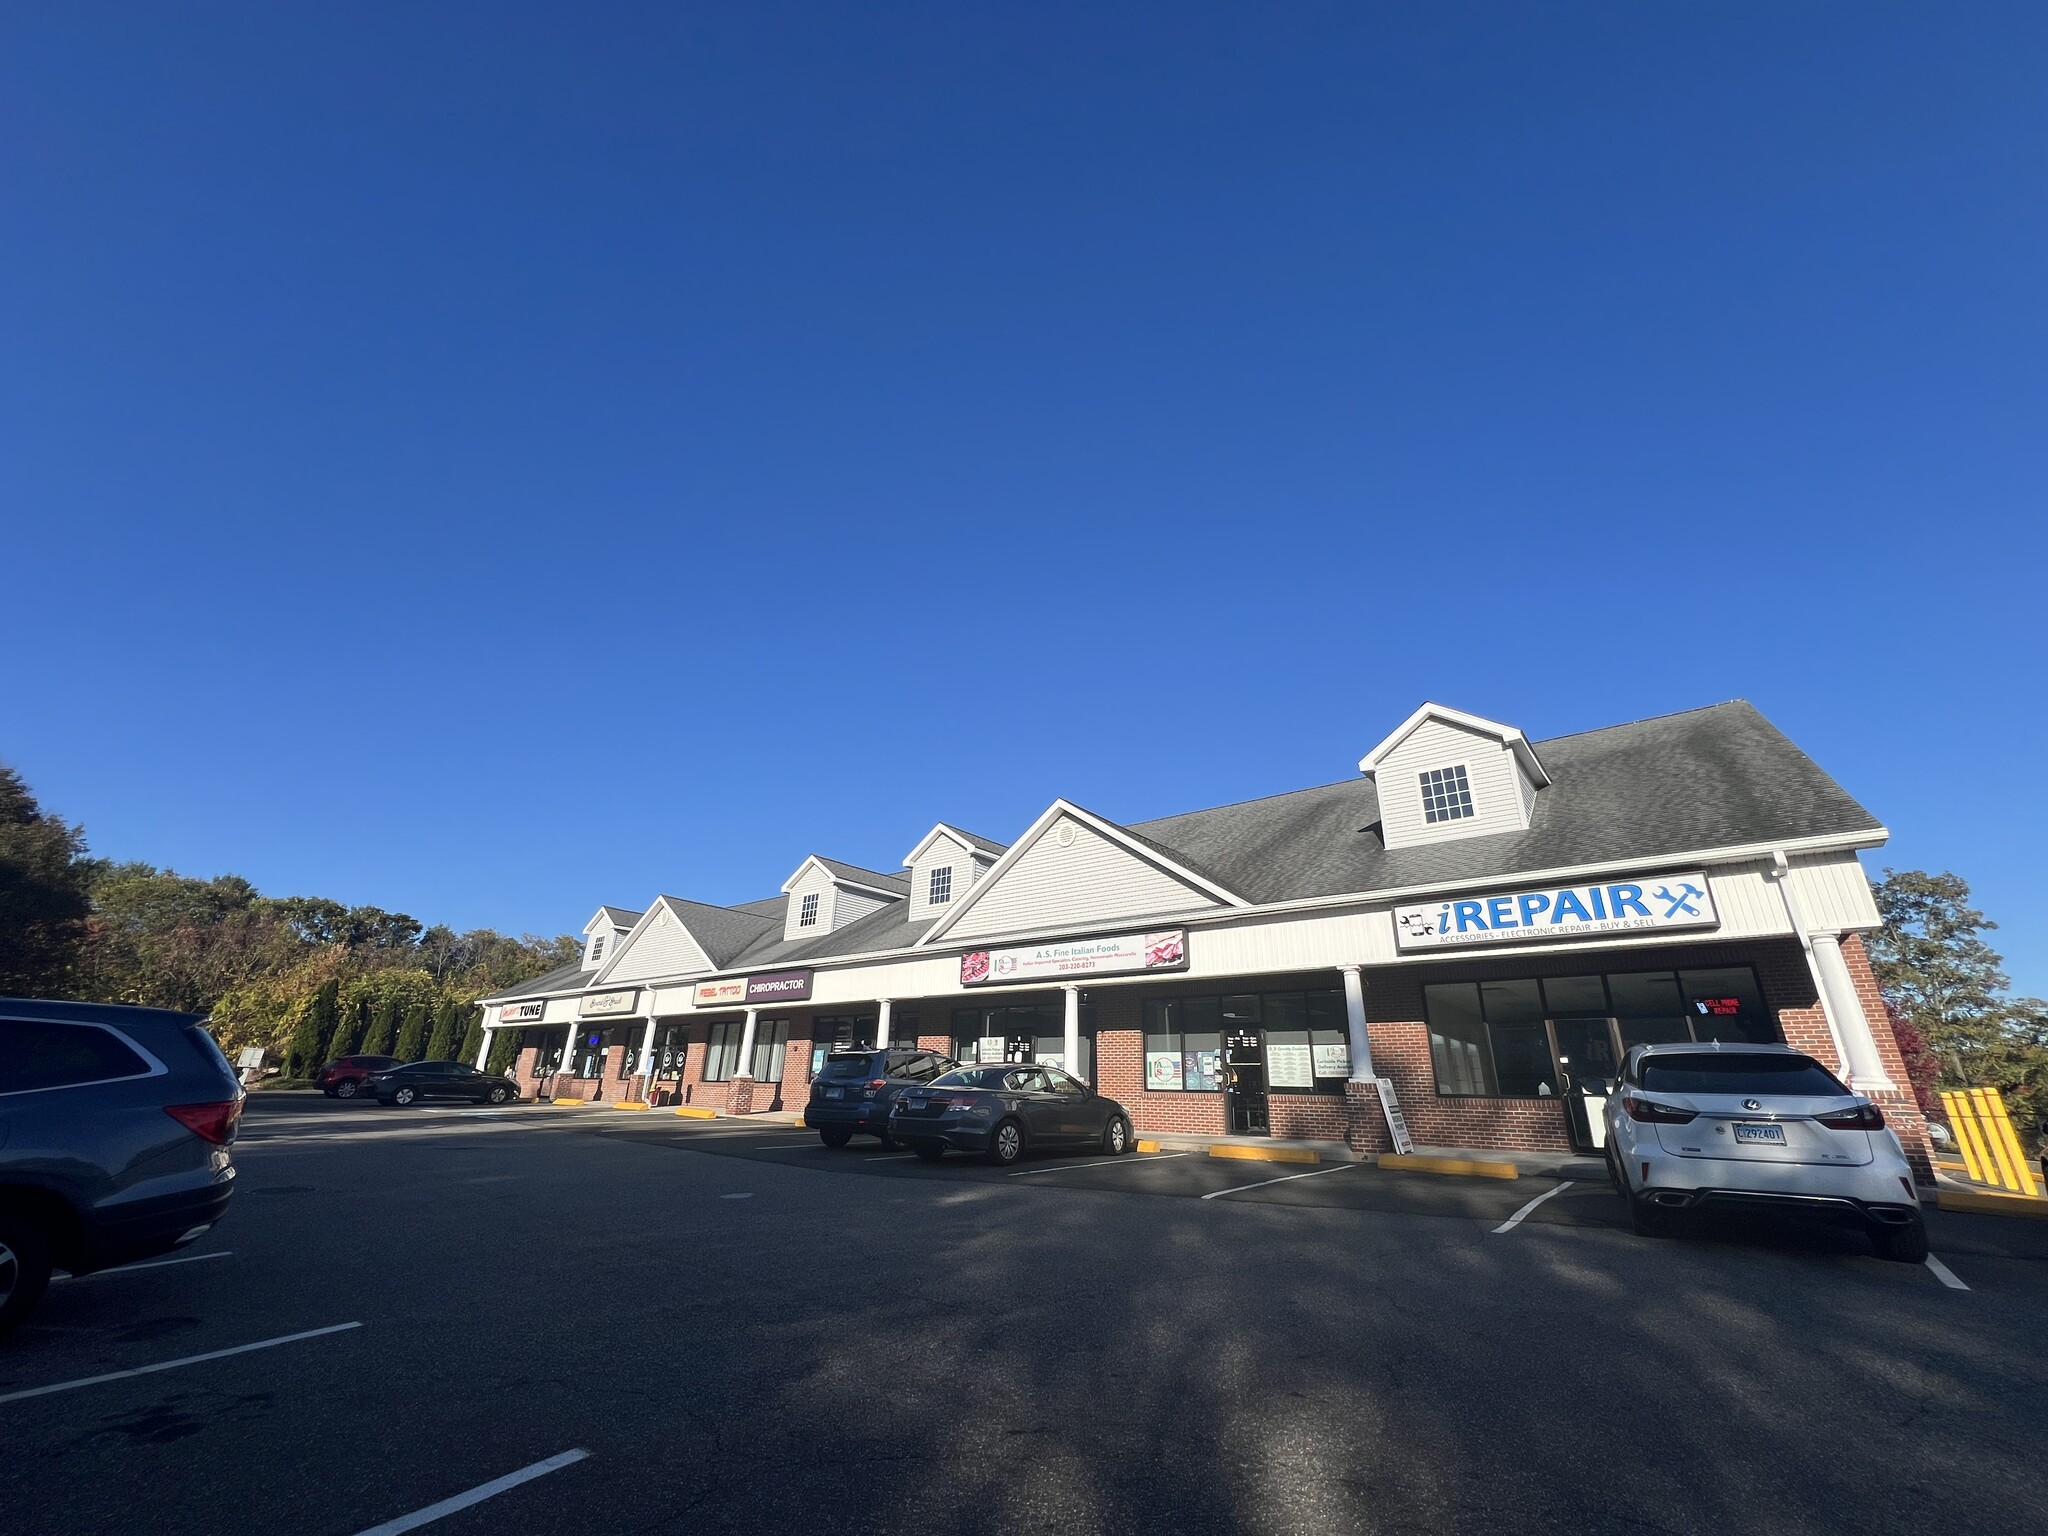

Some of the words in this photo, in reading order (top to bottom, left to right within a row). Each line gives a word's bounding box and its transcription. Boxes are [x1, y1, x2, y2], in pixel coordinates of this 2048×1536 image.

[1438, 884, 1653, 935] iREPAIR
[1440, 932, 1494, 944] ACCESSORIES
[1501, 927, 1556, 938] ELECTRONIC
[1559, 924, 1591, 934] REPAIR
[1600, 921, 1620, 930] BUY
[1623, 920, 1631, 928] &
[1633, 918, 1656, 927] SELL
[1036, 951, 1052, 959] A.S.
[1054, 949, 1069, 958] Fine
[1071, 947, 1094, 955] Italian
[1097, 944, 1120, 952] Foods
[700, 987, 717, 997] REBEL
[749, 979, 804, 994] CHIROPRACTOR
[520, 1004, 541, 1017] TUNE
